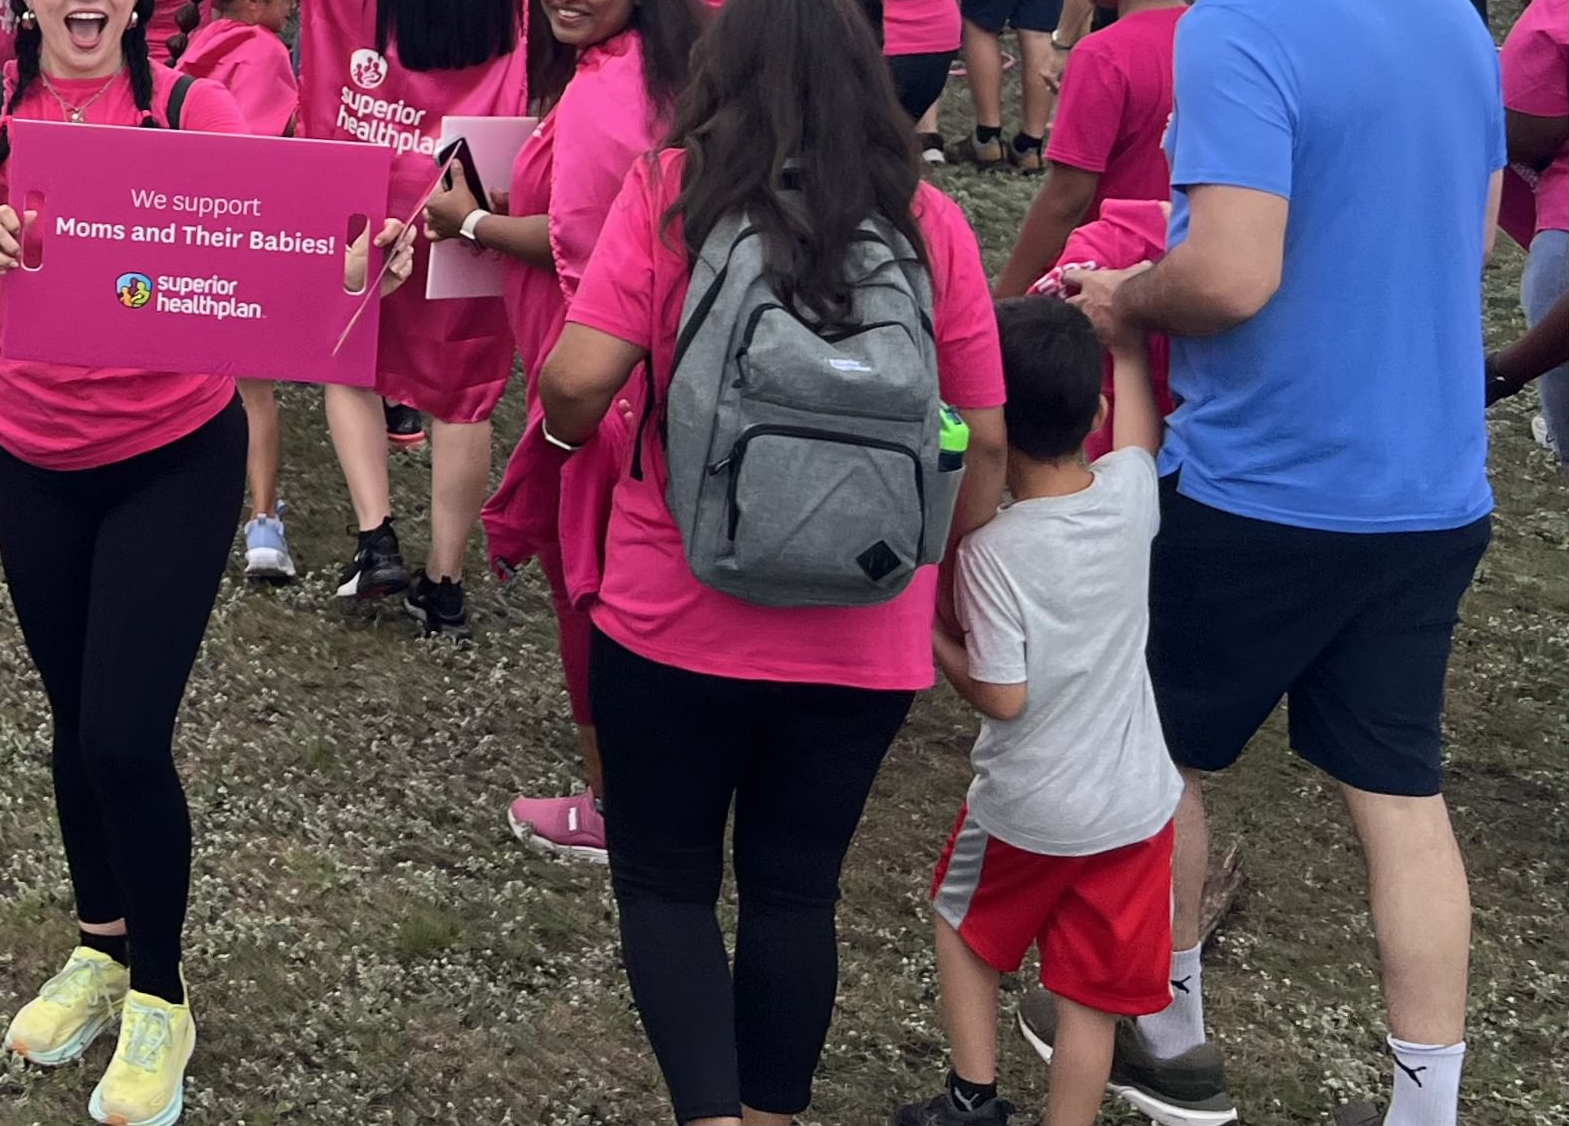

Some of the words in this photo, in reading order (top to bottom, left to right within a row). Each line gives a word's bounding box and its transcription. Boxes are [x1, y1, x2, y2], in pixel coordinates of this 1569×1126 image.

[340, 86, 427, 127] superior
[131, 188, 167, 210] We
[173, 193, 262, 218] support
[56, 217, 126, 240] Moms
[131, 223, 176, 244] and
[182, 225, 243, 248] Their
[249, 231, 336, 255] Babies!
[157, 275, 238, 296] superior
[157, 295, 262, 320] healthplan
